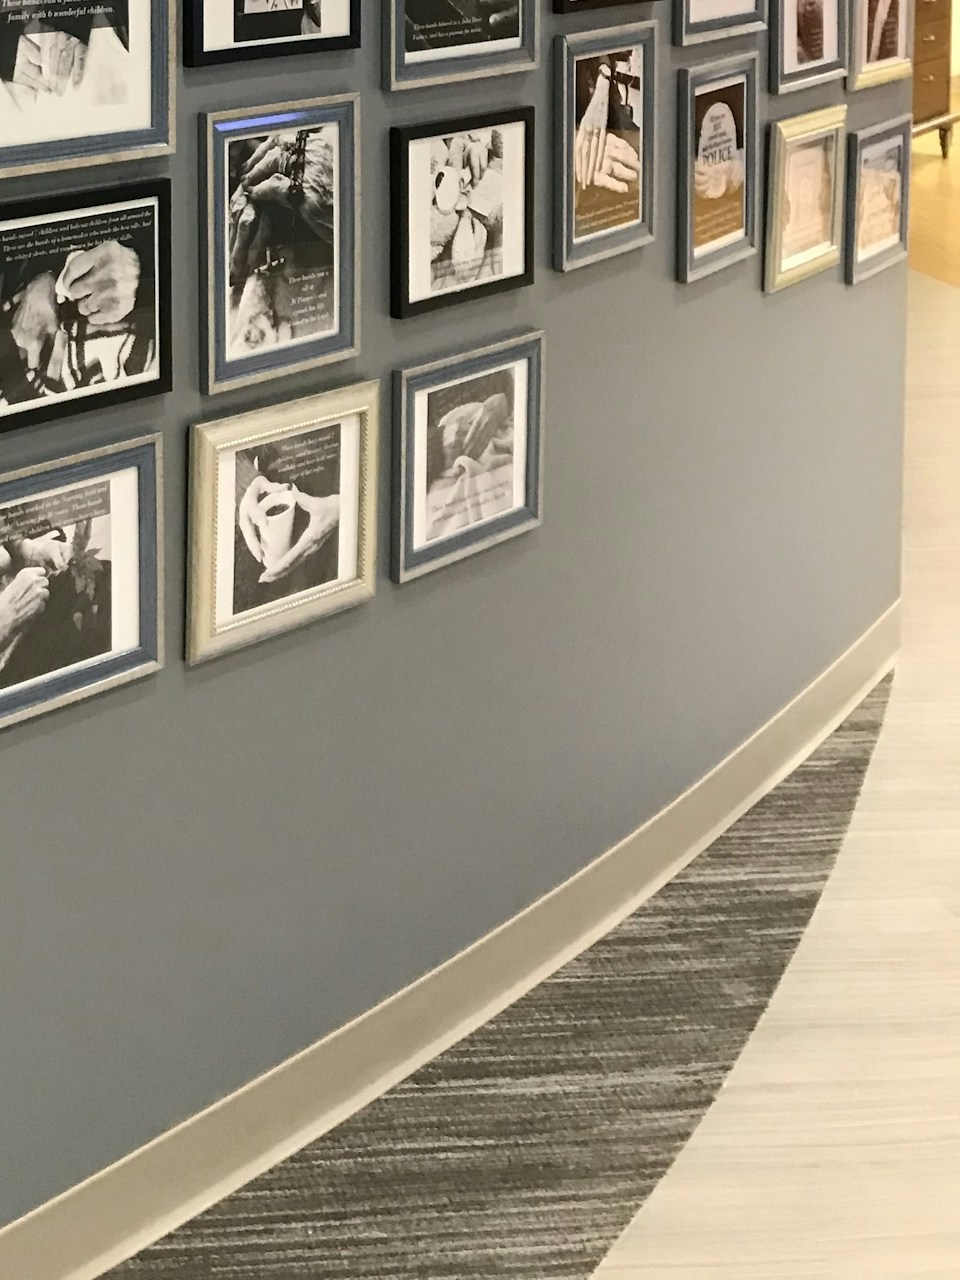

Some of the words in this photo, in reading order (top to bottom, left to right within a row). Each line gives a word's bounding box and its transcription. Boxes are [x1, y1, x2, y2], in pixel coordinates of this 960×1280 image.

[7, 11, 30, 23] family
[31, 10, 47, 20] with
[53, 6, 86, 18] wonderful
[703, 145, 733, 167] POLICE
